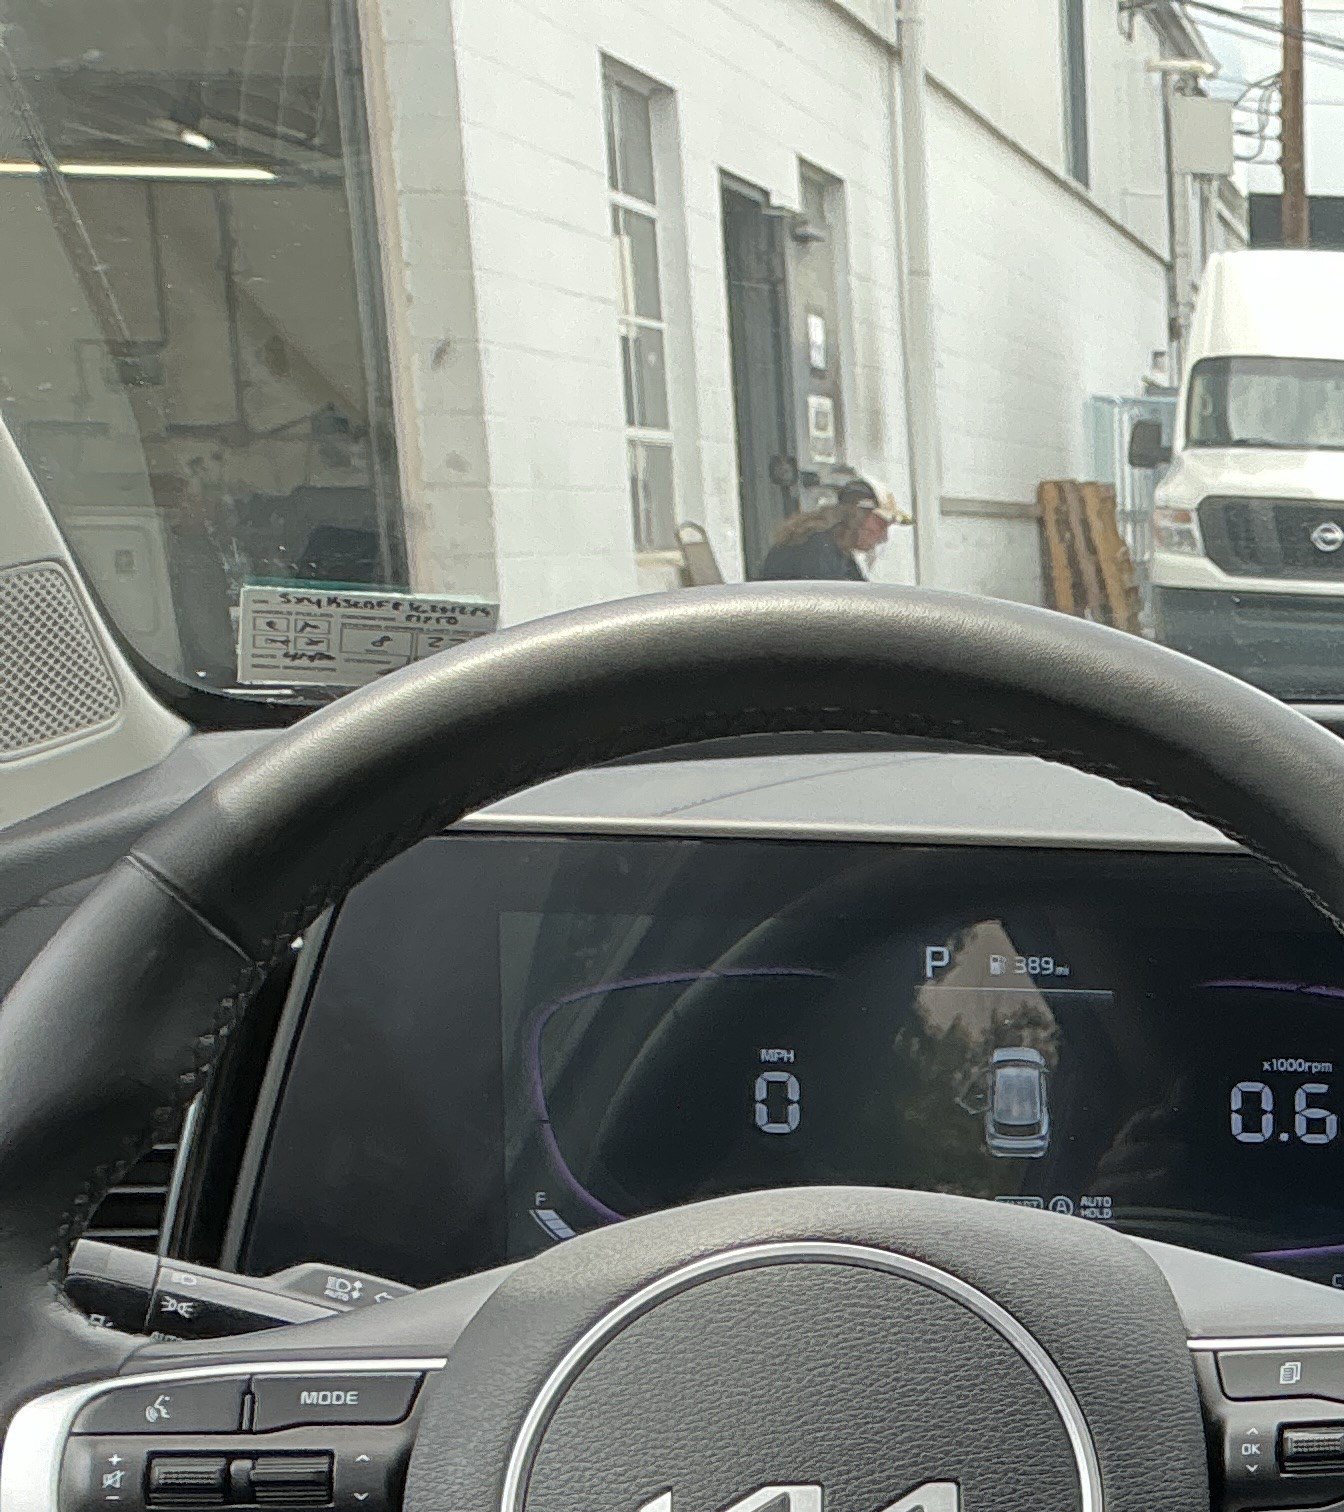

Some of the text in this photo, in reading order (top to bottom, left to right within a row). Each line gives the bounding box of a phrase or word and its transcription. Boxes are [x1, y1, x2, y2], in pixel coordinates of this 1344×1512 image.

[925, 945, 950, 978] P
[760, 1048, 795, 1063] MPH
[754, 1071, 801, 1135] 0
[1230, 1081, 1338, 1144] 0.6
[534, 1191, 546, 1206] F
[1080, 1195, 1113, 1207] AUTO
[300, 1390, 359, 1406] MODE
[1240, 1443, 1261, 1456] OK
